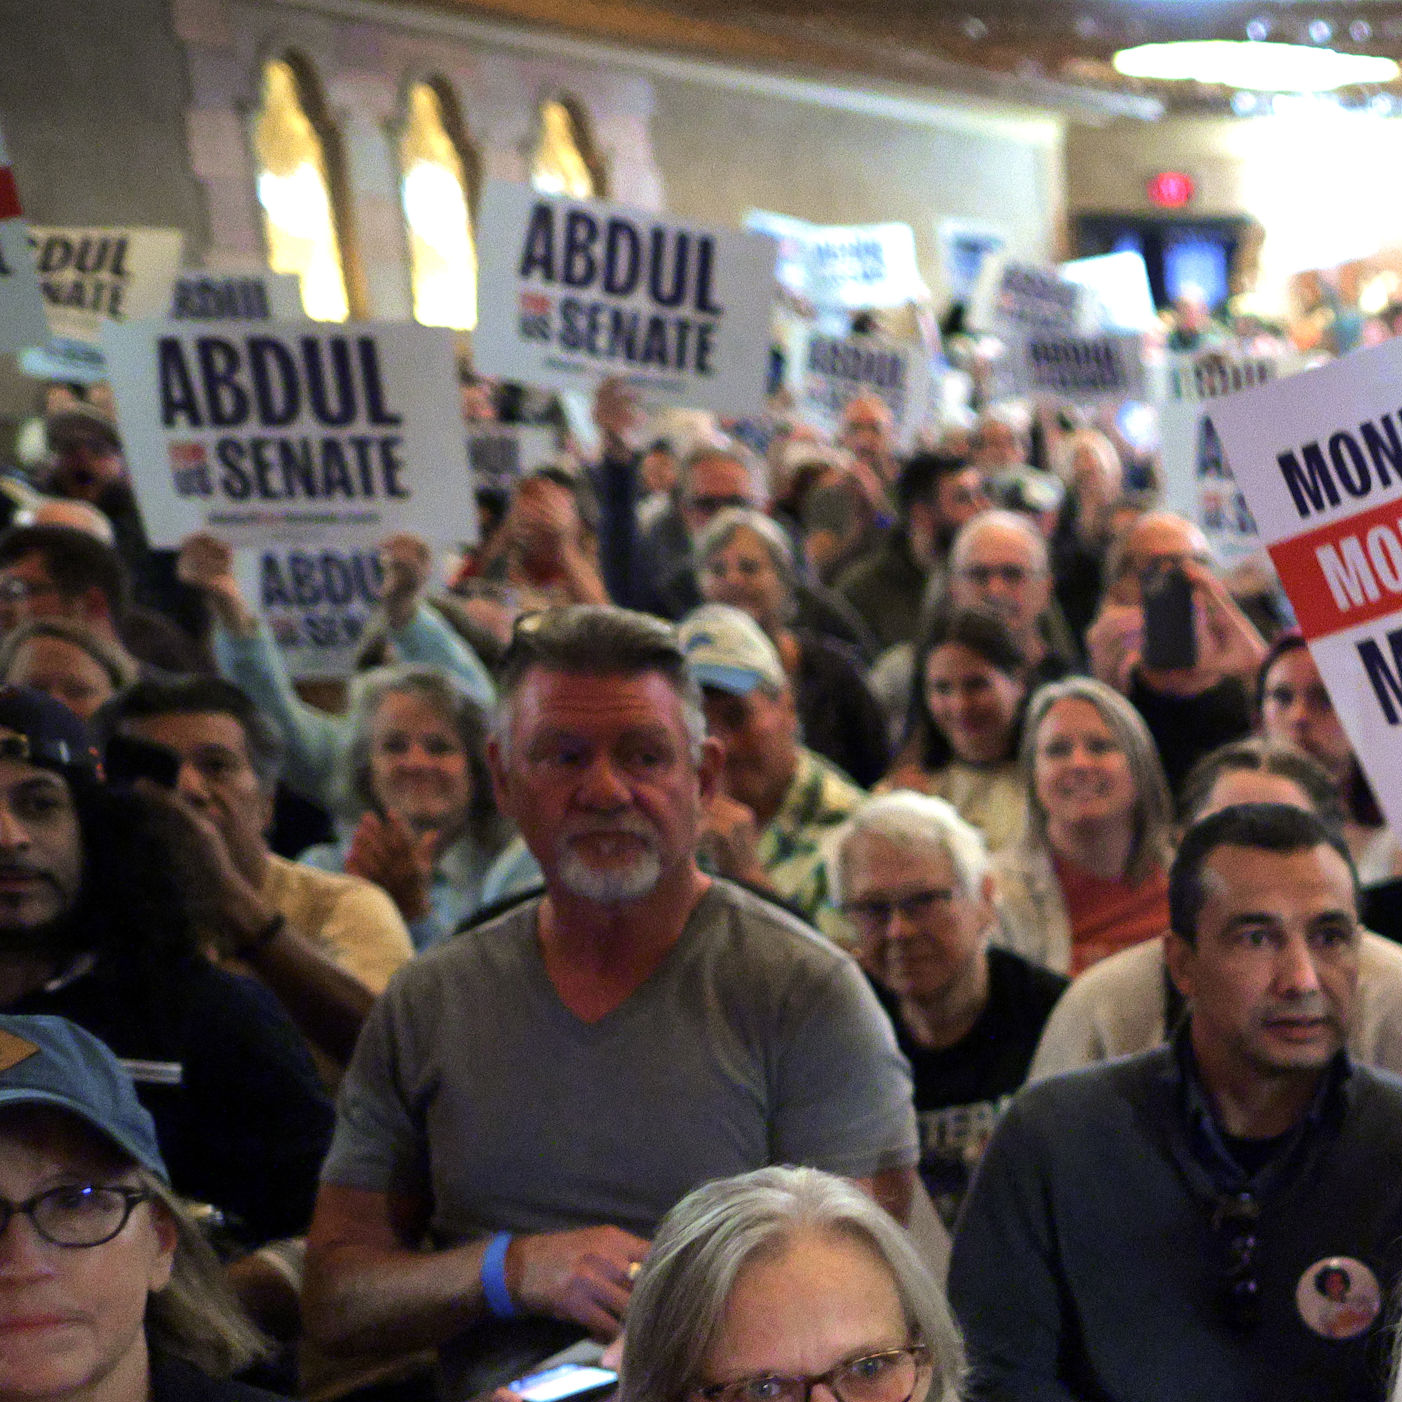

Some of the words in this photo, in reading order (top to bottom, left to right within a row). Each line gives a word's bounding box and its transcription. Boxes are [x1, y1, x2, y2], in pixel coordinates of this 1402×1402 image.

[28, 236, 133, 277] DUL
[519, 201, 723, 315] ABDUL
[559, 297, 717, 376] SENATE
[158, 334, 403, 428] ABDUL
[215, 436, 410, 500] SENATE
